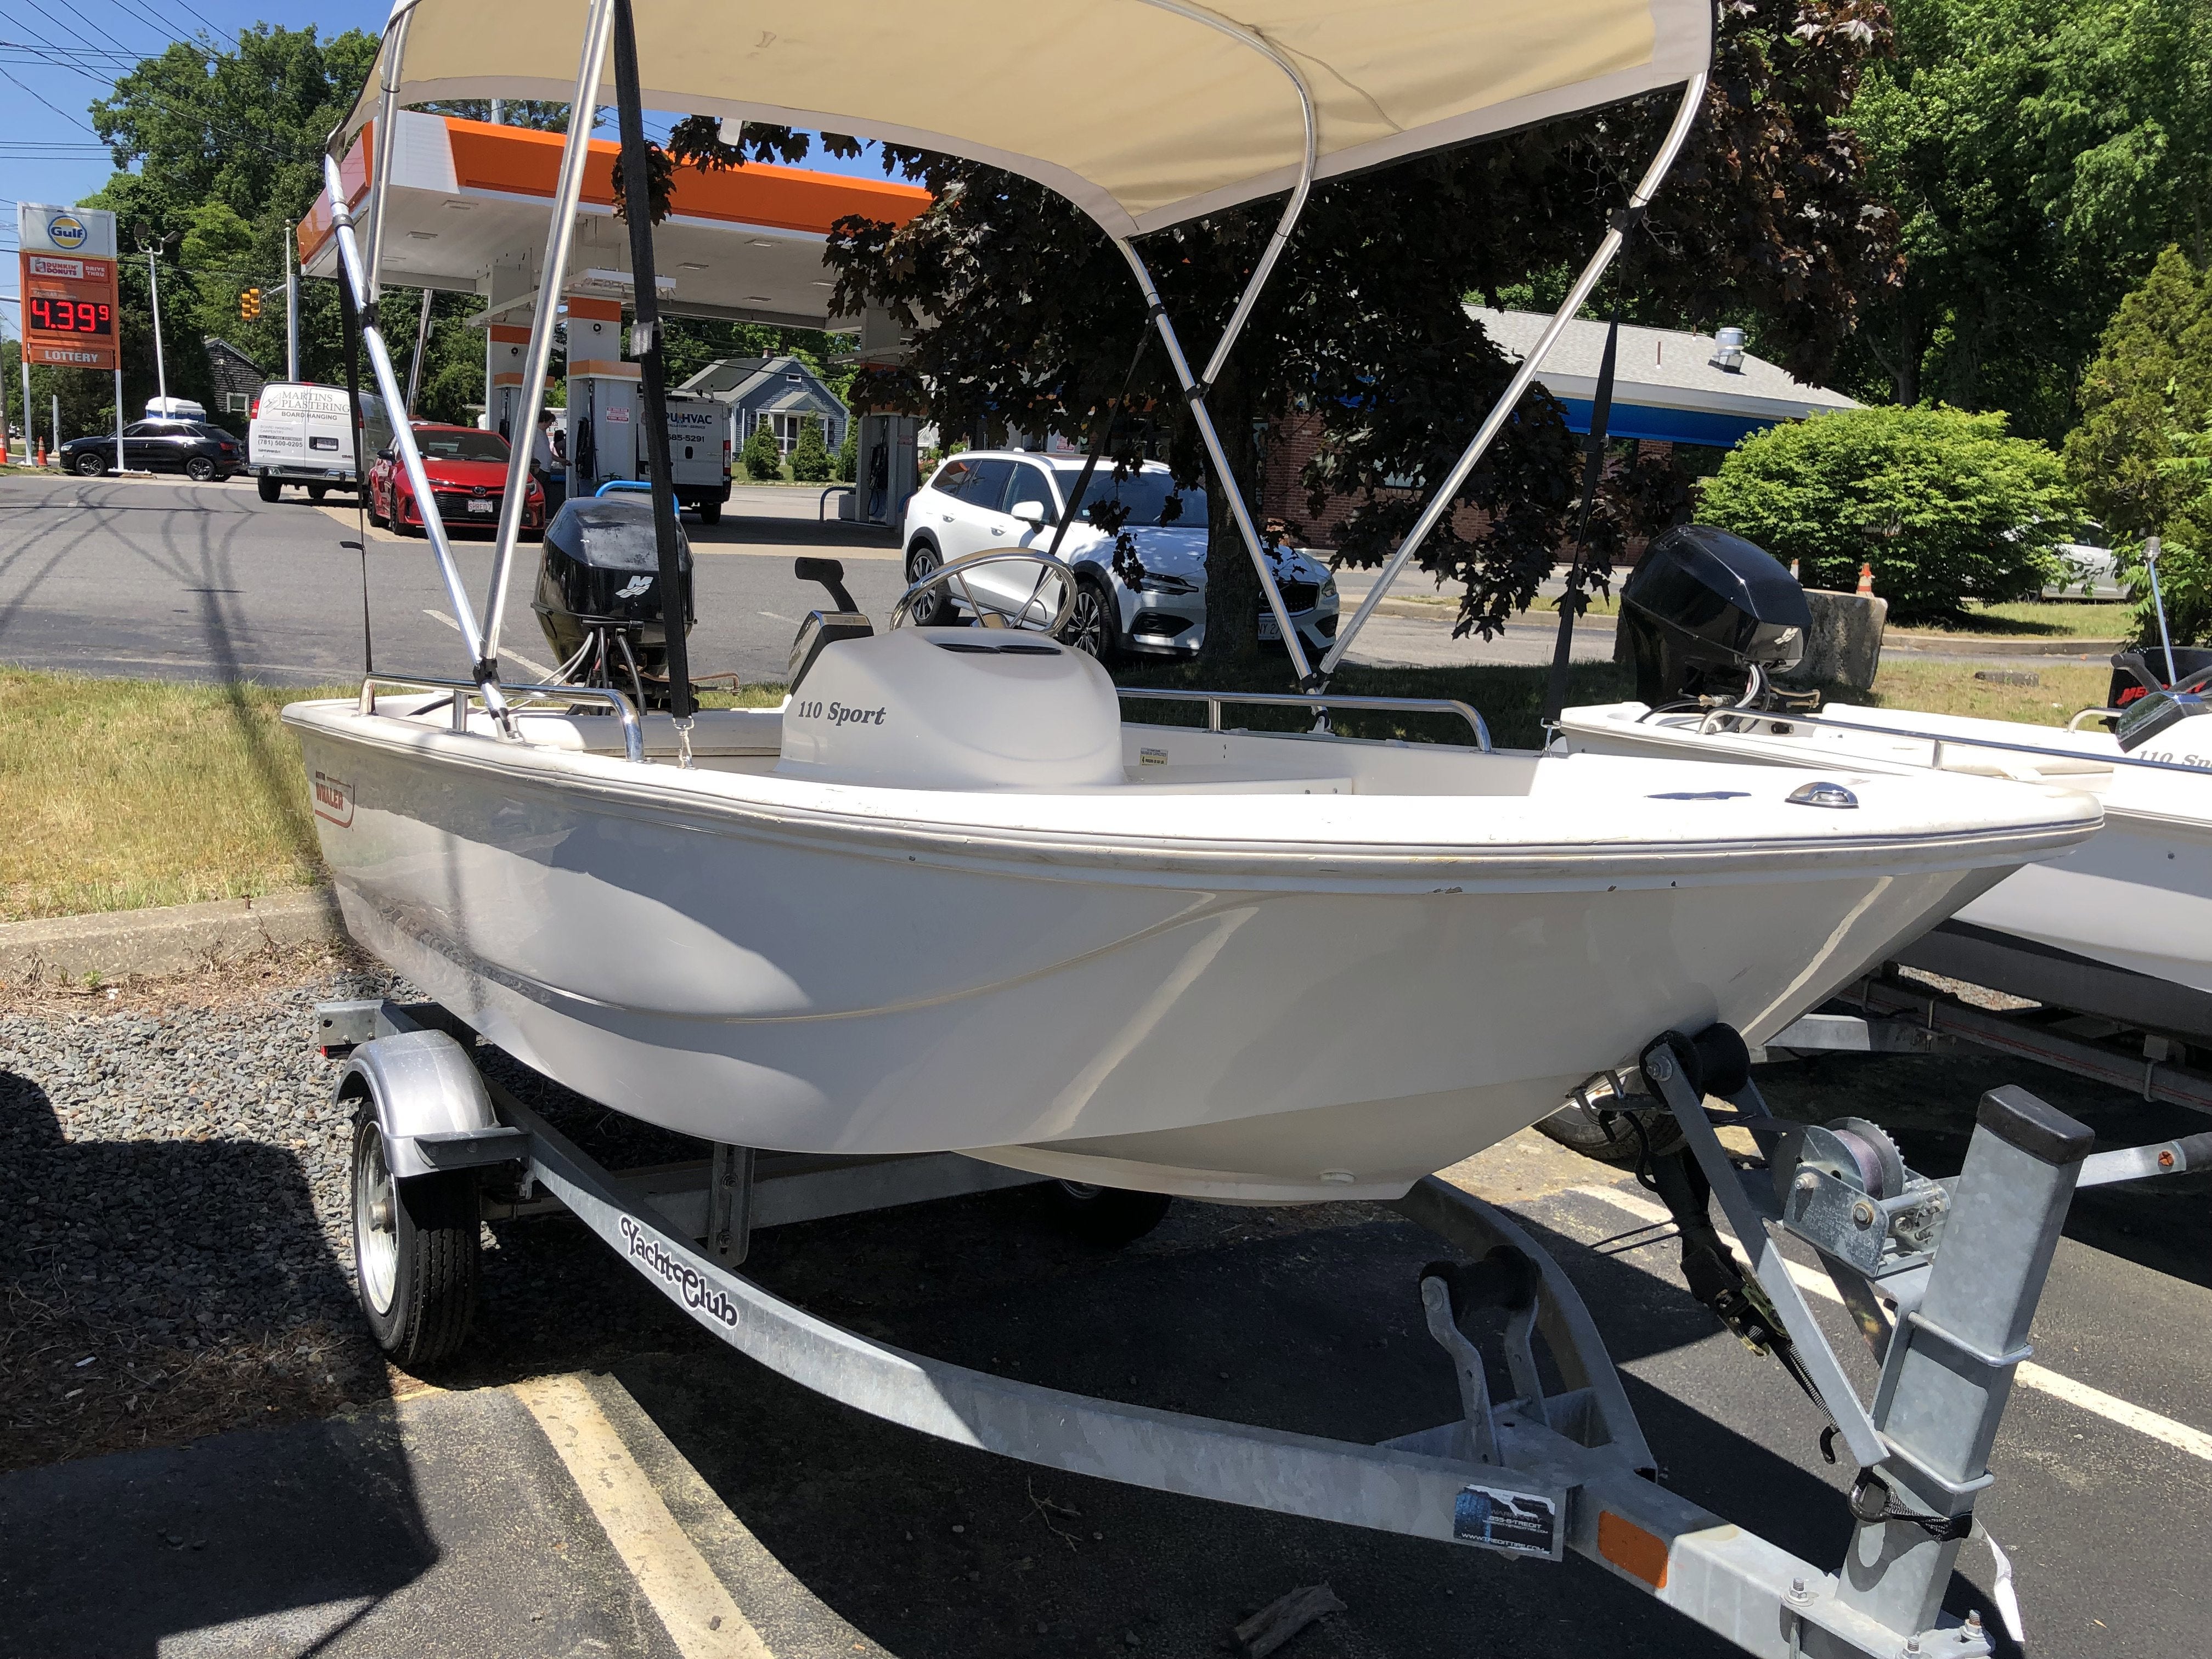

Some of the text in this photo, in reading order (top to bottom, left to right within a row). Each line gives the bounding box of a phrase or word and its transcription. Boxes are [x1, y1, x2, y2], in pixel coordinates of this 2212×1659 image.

[51, 227, 83, 238] Gulf
[45, 350, 98, 363] LOTTERY
[281, 391, 332, 402] MARTINS
[281, 400, 350, 413] PLASTERING
[682, 413, 712, 424] HVAC
[798, 701, 887, 726] 110 Sport
[2140, 750, 2173, 763] 110
[316, 782, 343, 811] WHALER
